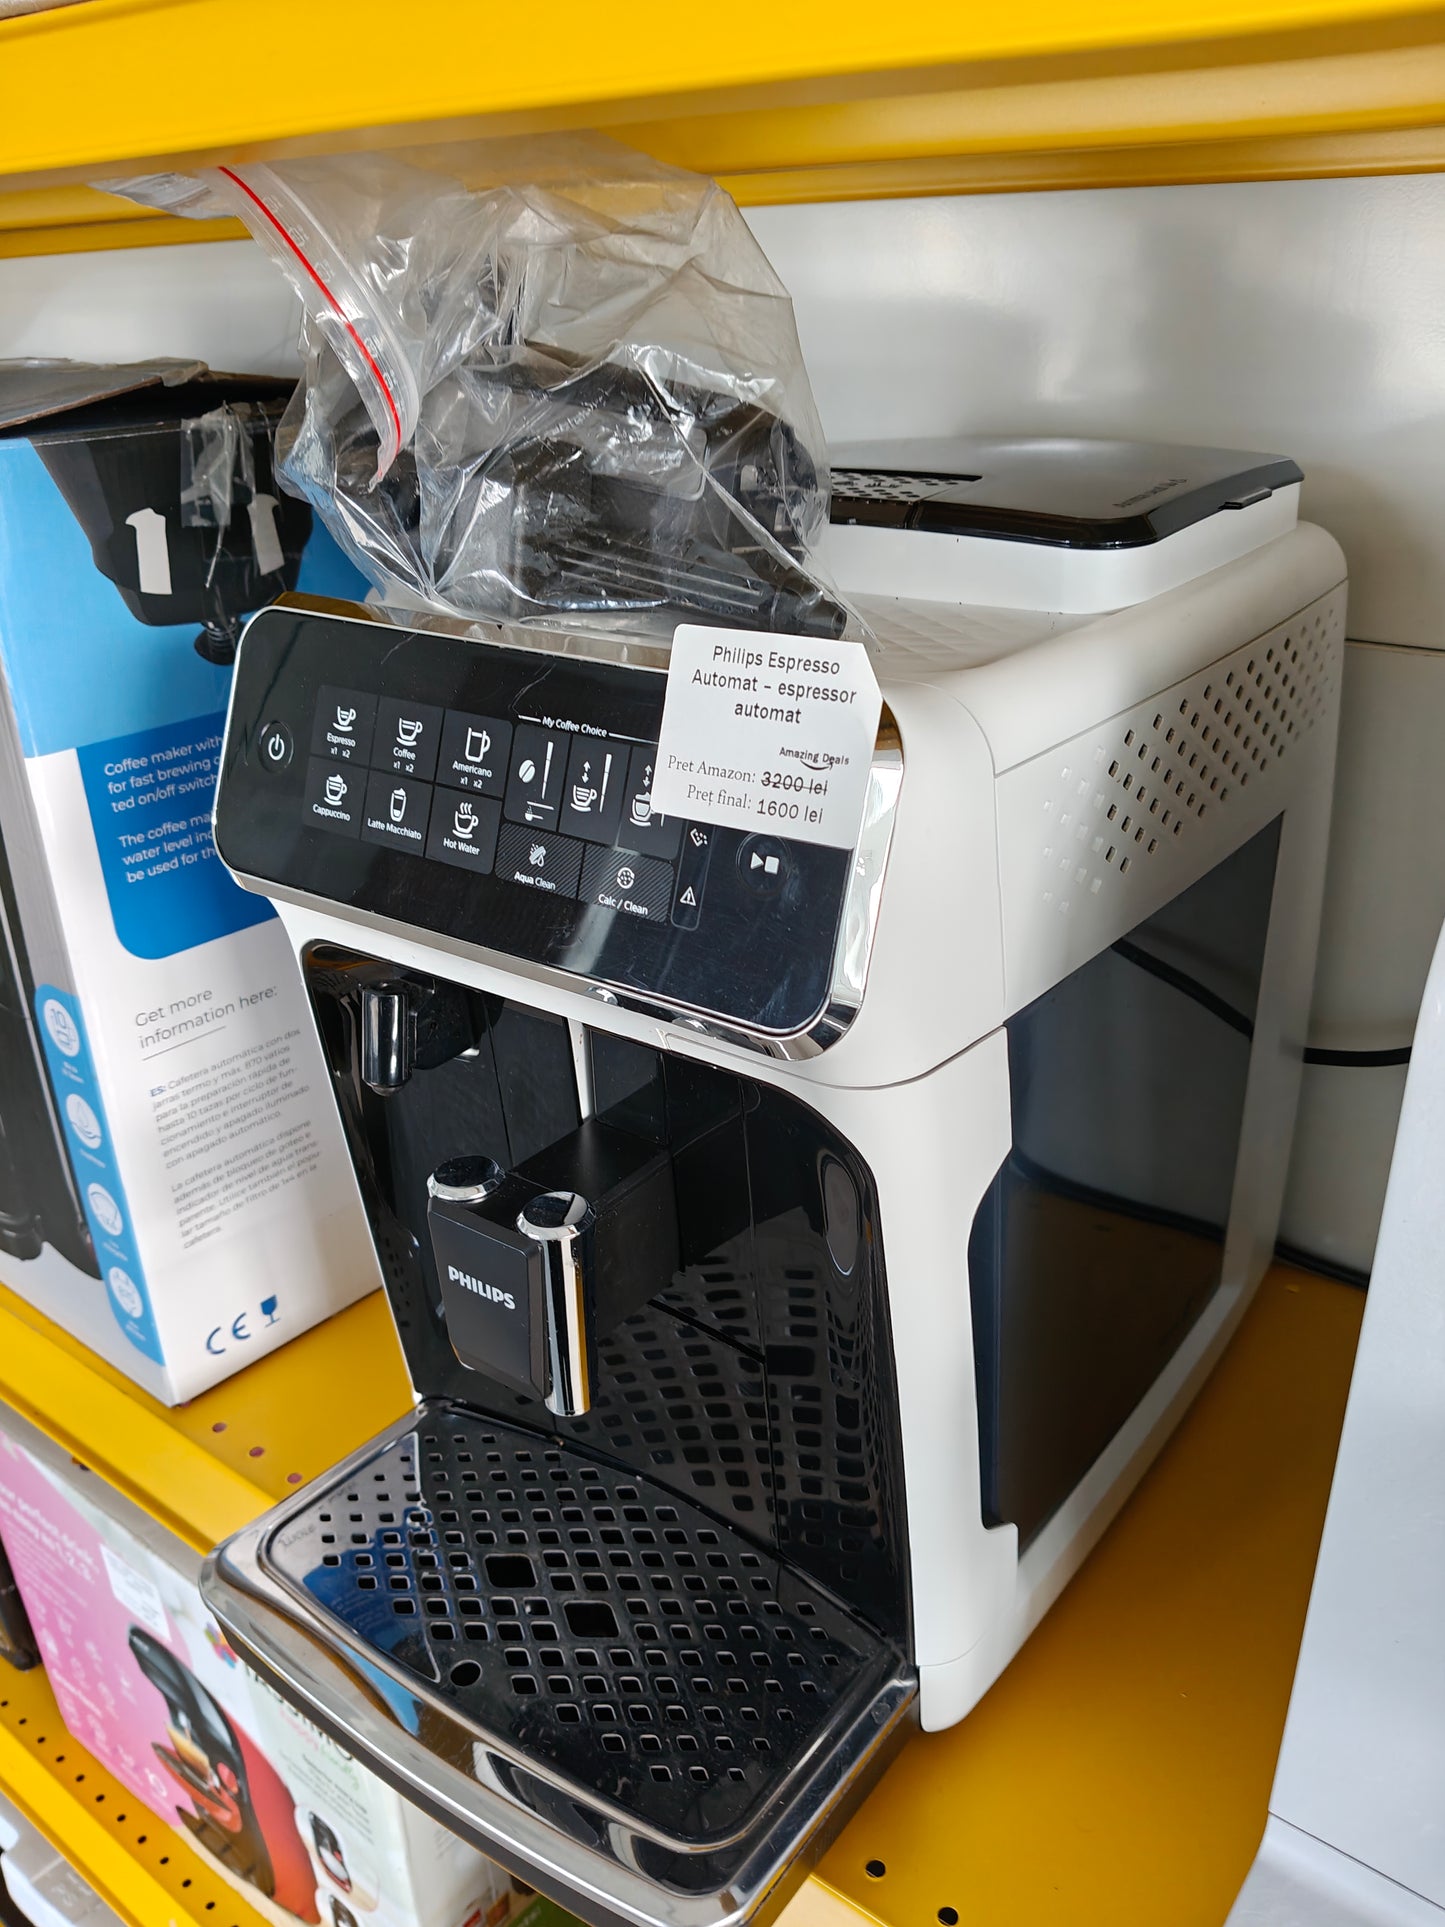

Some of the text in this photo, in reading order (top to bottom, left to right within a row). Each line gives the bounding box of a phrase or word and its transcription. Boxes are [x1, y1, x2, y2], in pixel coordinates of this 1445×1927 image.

[712, 645, 841, 675] Philips Espresso
[691, 668, 758, 693] Automat
[778, 681, 857, 705] espressor
[734, 702, 802, 724] automat
[542, 715, 608, 738] My Coffee Choice
[326, 732, 356, 748] Espresso
[104, 735, 223, 776] Coffee maker with
[331, 747, 351, 759] x1 x2
[393, 747, 416, 761] Coffee
[779, 746, 850, 767] Amazing Deals
[107, 781, 127, 795] for
[130, 773, 155, 788] fast
[157, 758, 211, 781] brewing
[393, 761, 414, 773] x1 x2
[452, 760, 492, 778] Americano
[696, 760, 756, 783] Amazon:
[760, 771, 804, 792] 3200
[808, 778, 828, 796] lei
[460, 777, 483, 789] x1 x2
[111, 797, 135, 813] ted
[138, 783, 176, 806] on/off
[717, 789, 752, 809] final:
[756, 799, 799, 819] 1600
[804, 805, 823, 825] lei
[312, 803, 351, 822] Cappuccino
[118, 832, 145, 849] The
[147, 820, 187, 840] coffee
[367, 818, 422, 840] Latte Macchiato
[122, 845, 160, 866] water
[163, 834, 193, 853] level
[443, 838, 480, 856] Hot Water
[126, 869, 145, 883] be
[147, 857, 179, 877] used
[181, 851, 199, 866] for
[514, 871, 556, 891] Aqua Clean
[598, 893, 617, 907] Calc
[624, 900, 649, 916] Clean
[135, 989, 213, 1028] Get more
[138, 985, 278, 1049] information here:
[447, 1265, 516, 1310] PHILIPS
